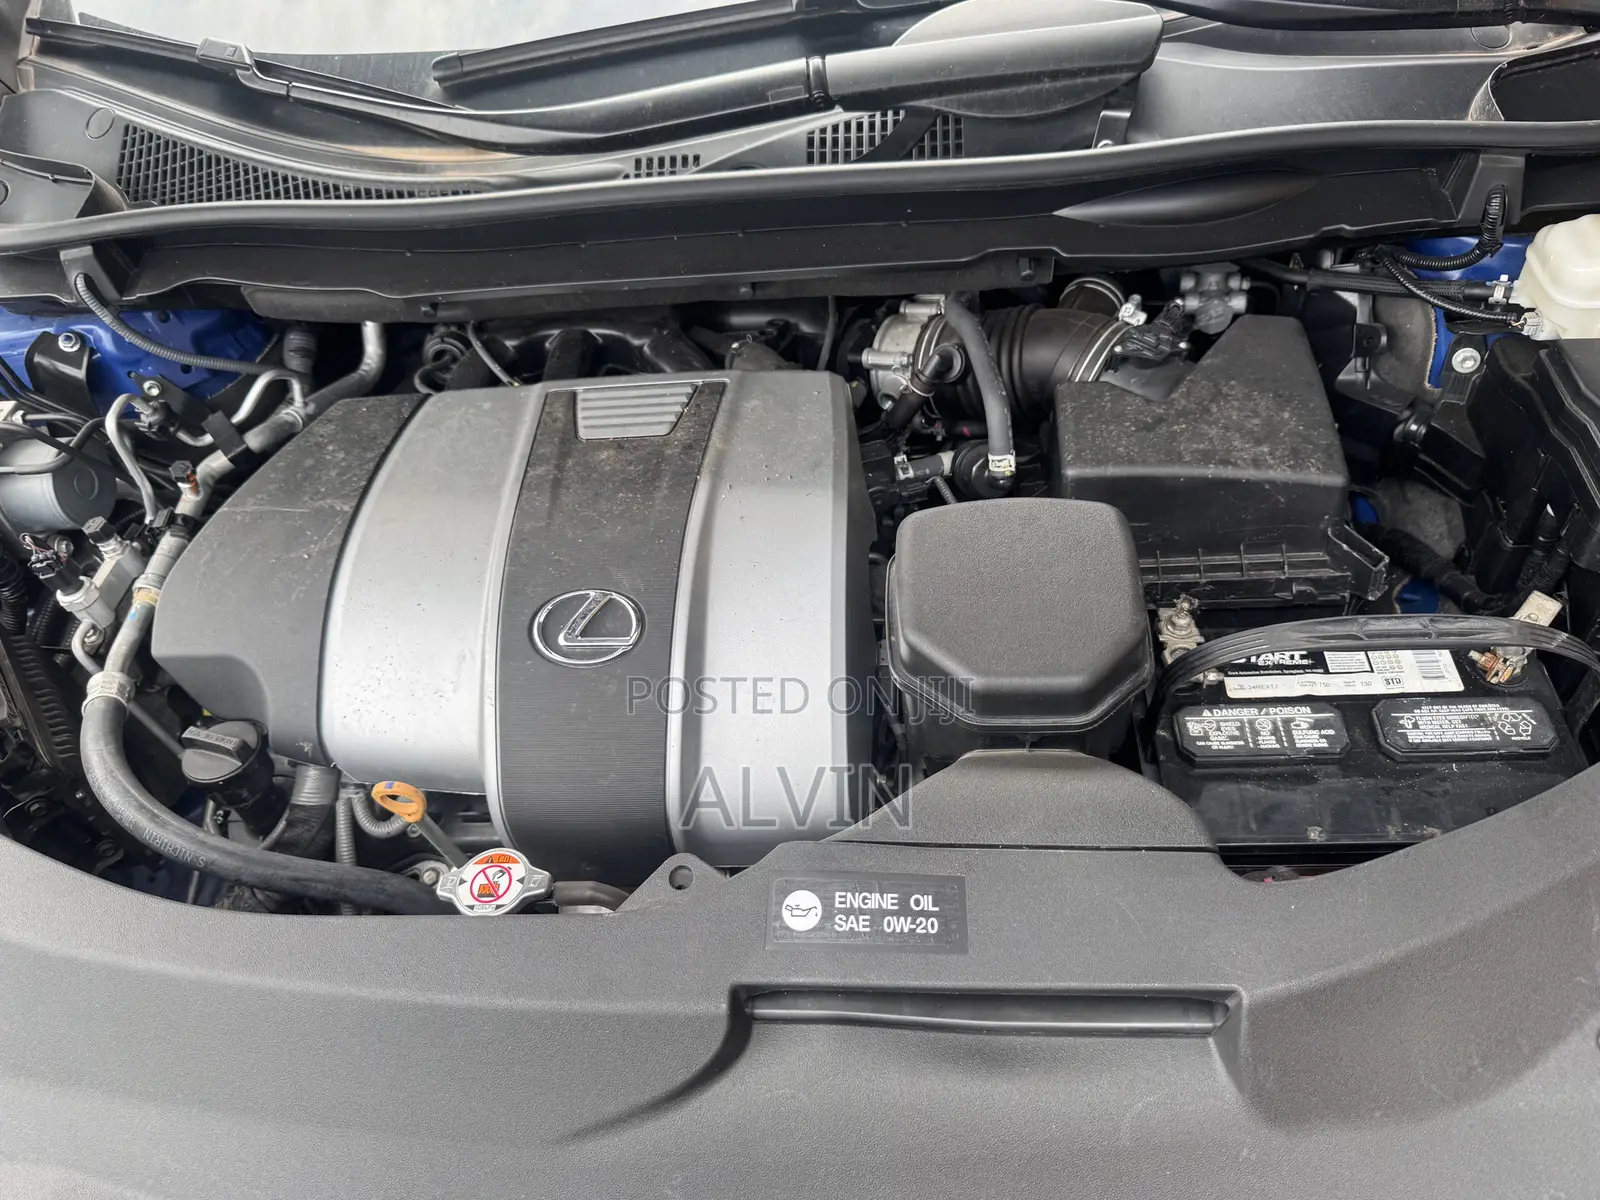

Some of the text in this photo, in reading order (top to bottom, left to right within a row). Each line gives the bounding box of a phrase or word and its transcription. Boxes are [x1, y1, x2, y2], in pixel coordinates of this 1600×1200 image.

[1231, 650, 1308, 663] ART
[1383, 677, 1402, 686] STD
[1212, 707, 1259, 717] DANGER
[1268, 705, 1312, 715] POISON
[834, 891, 940, 912] ENGINE OIL
[834, 914, 939, 934] SAE 0W-20
